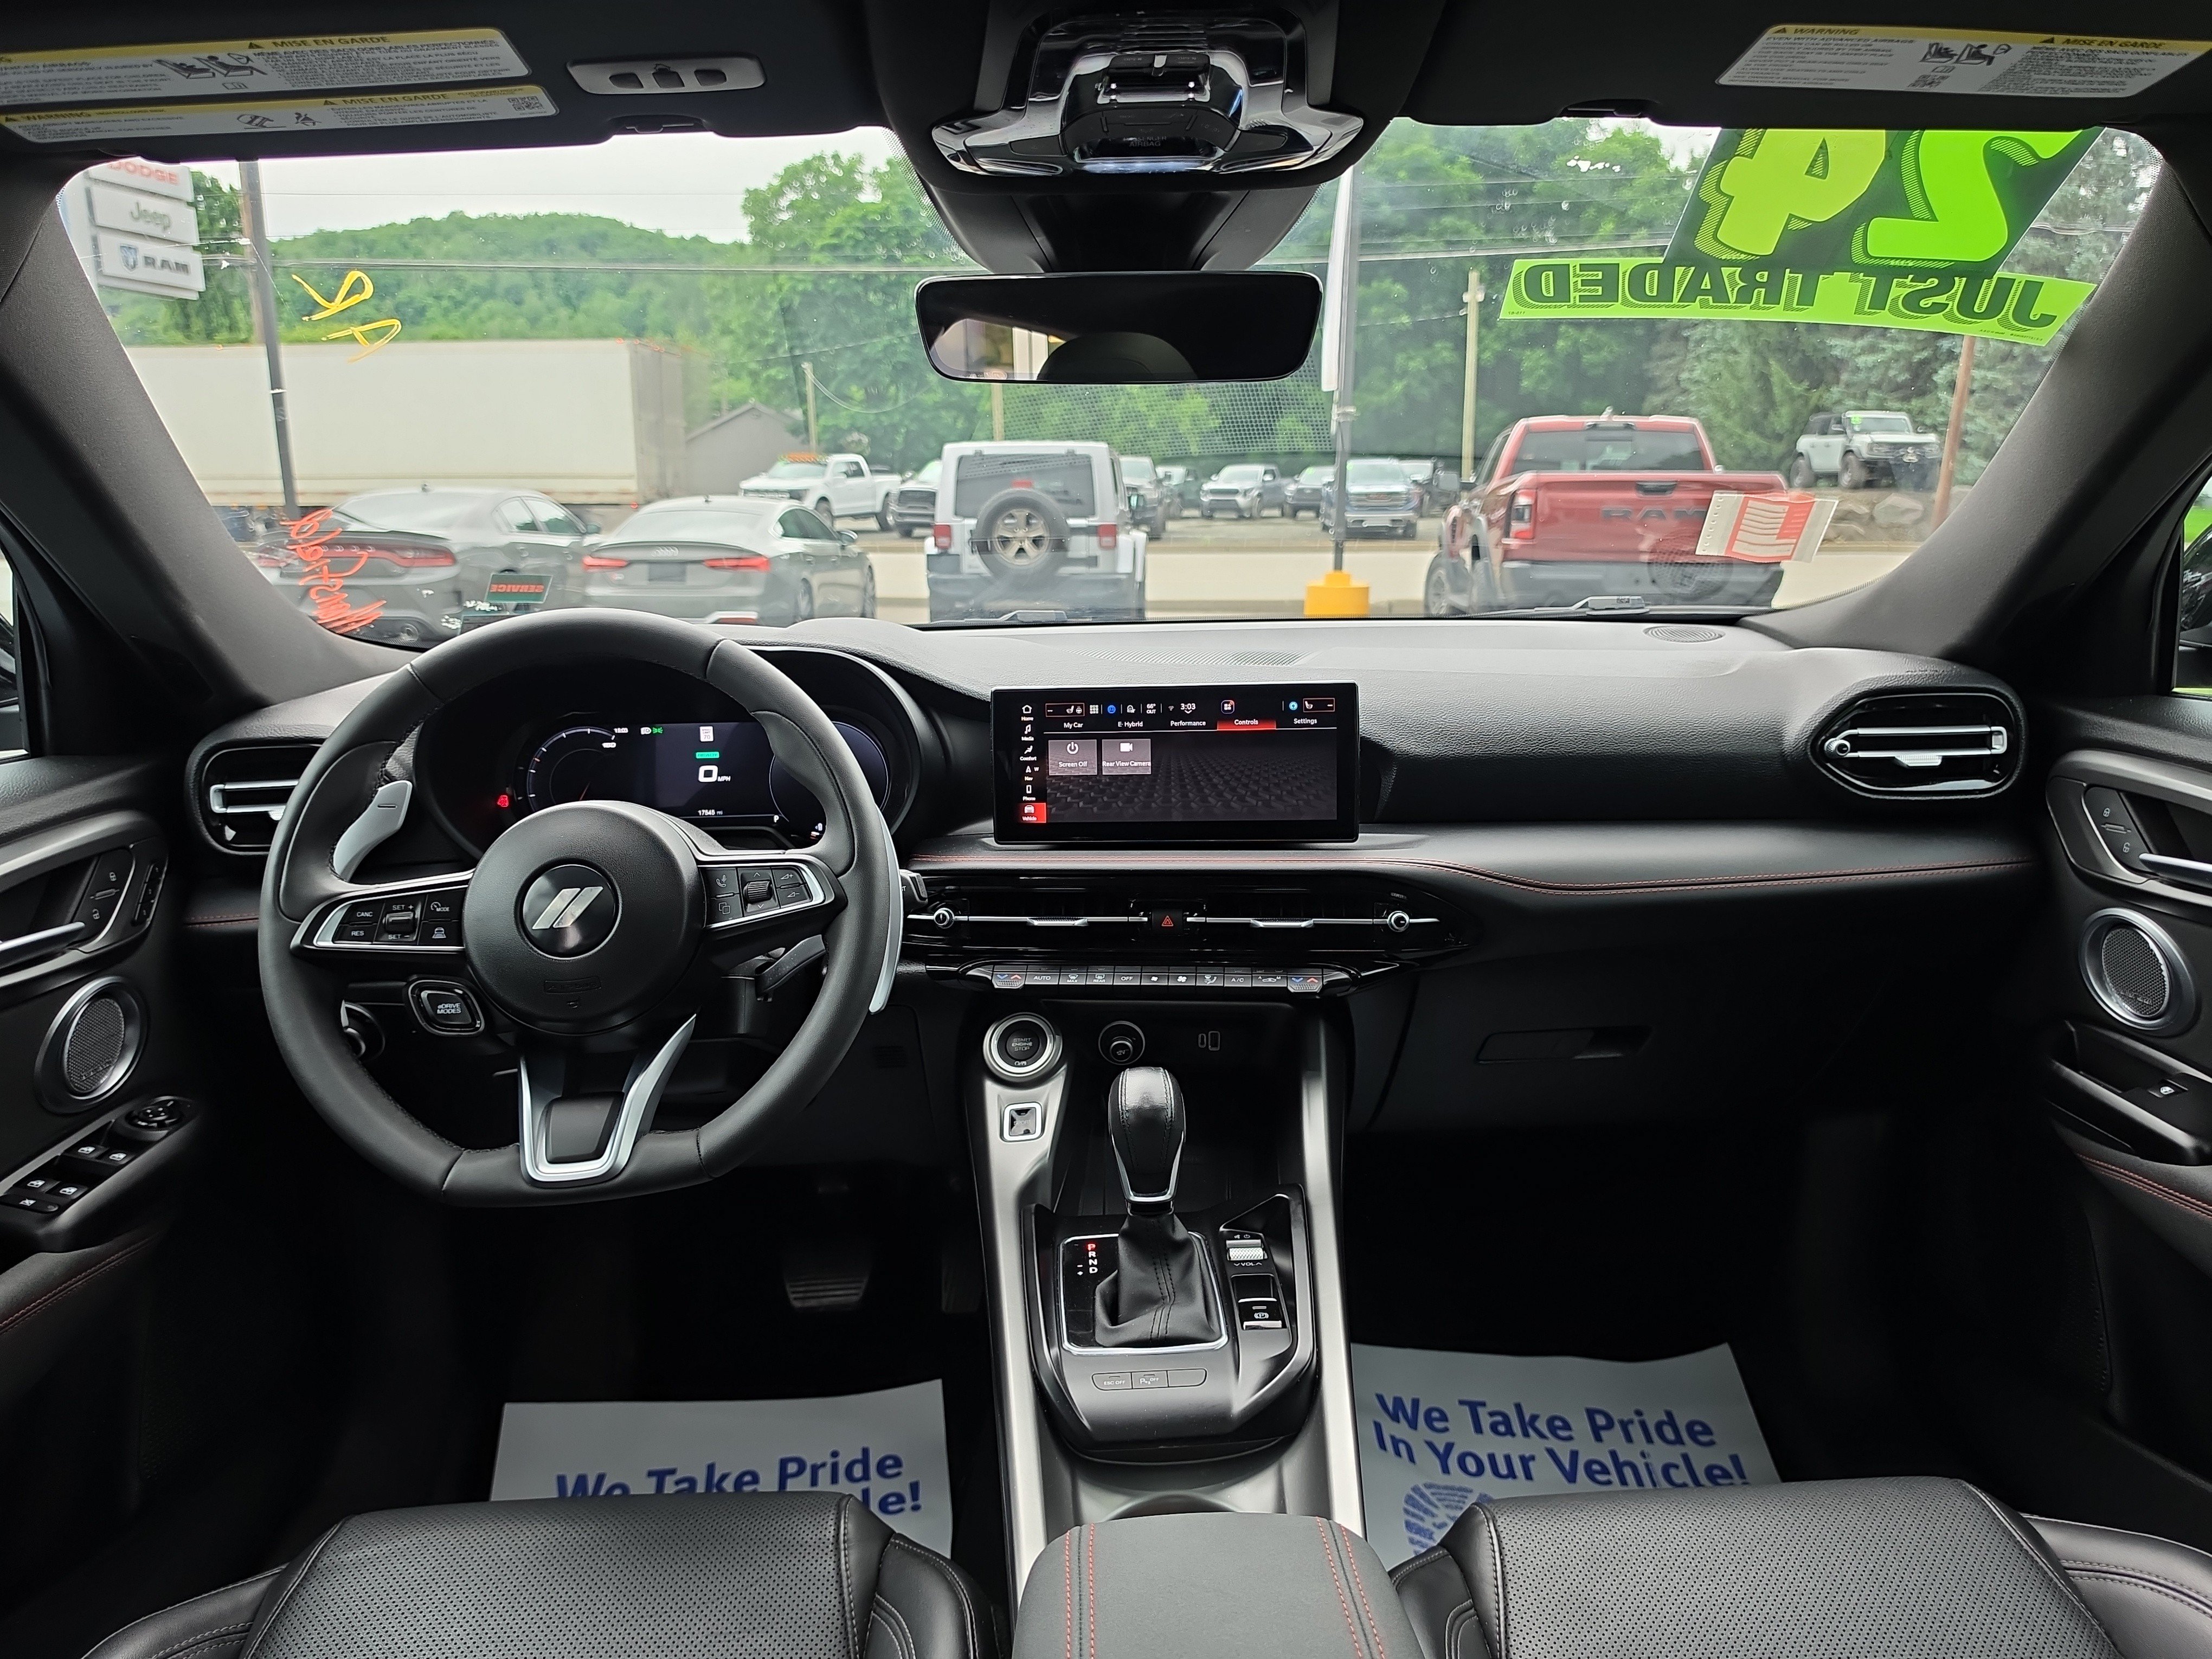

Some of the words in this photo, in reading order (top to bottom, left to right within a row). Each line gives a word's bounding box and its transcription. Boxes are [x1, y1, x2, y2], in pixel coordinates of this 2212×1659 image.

[272, 40, 311, 48] MISE
[337, 36, 390, 45] GARDE
[406, 93, 450, 102] GARDE
[130, 202, 171, 231] Jeep
[143, 255, 190, 274] RAM
[1600, 507, 1707, 520] RAM
[698, 765, 718, 782] 0
[1375, 1392, 1449, 1434] We
[1457, 1397, 1574, 1442] Take
[1584, 1406, 1716, 1447] Pride
[1373, 1420, 1417, 1464] In
[1424, 1439, 1536, 1482] Your
[1546, 1448, 1750, 1487] Vehicle!
[647, 1463, 760, 1495] Take
[778, 1446, 904, 1492] Pride
